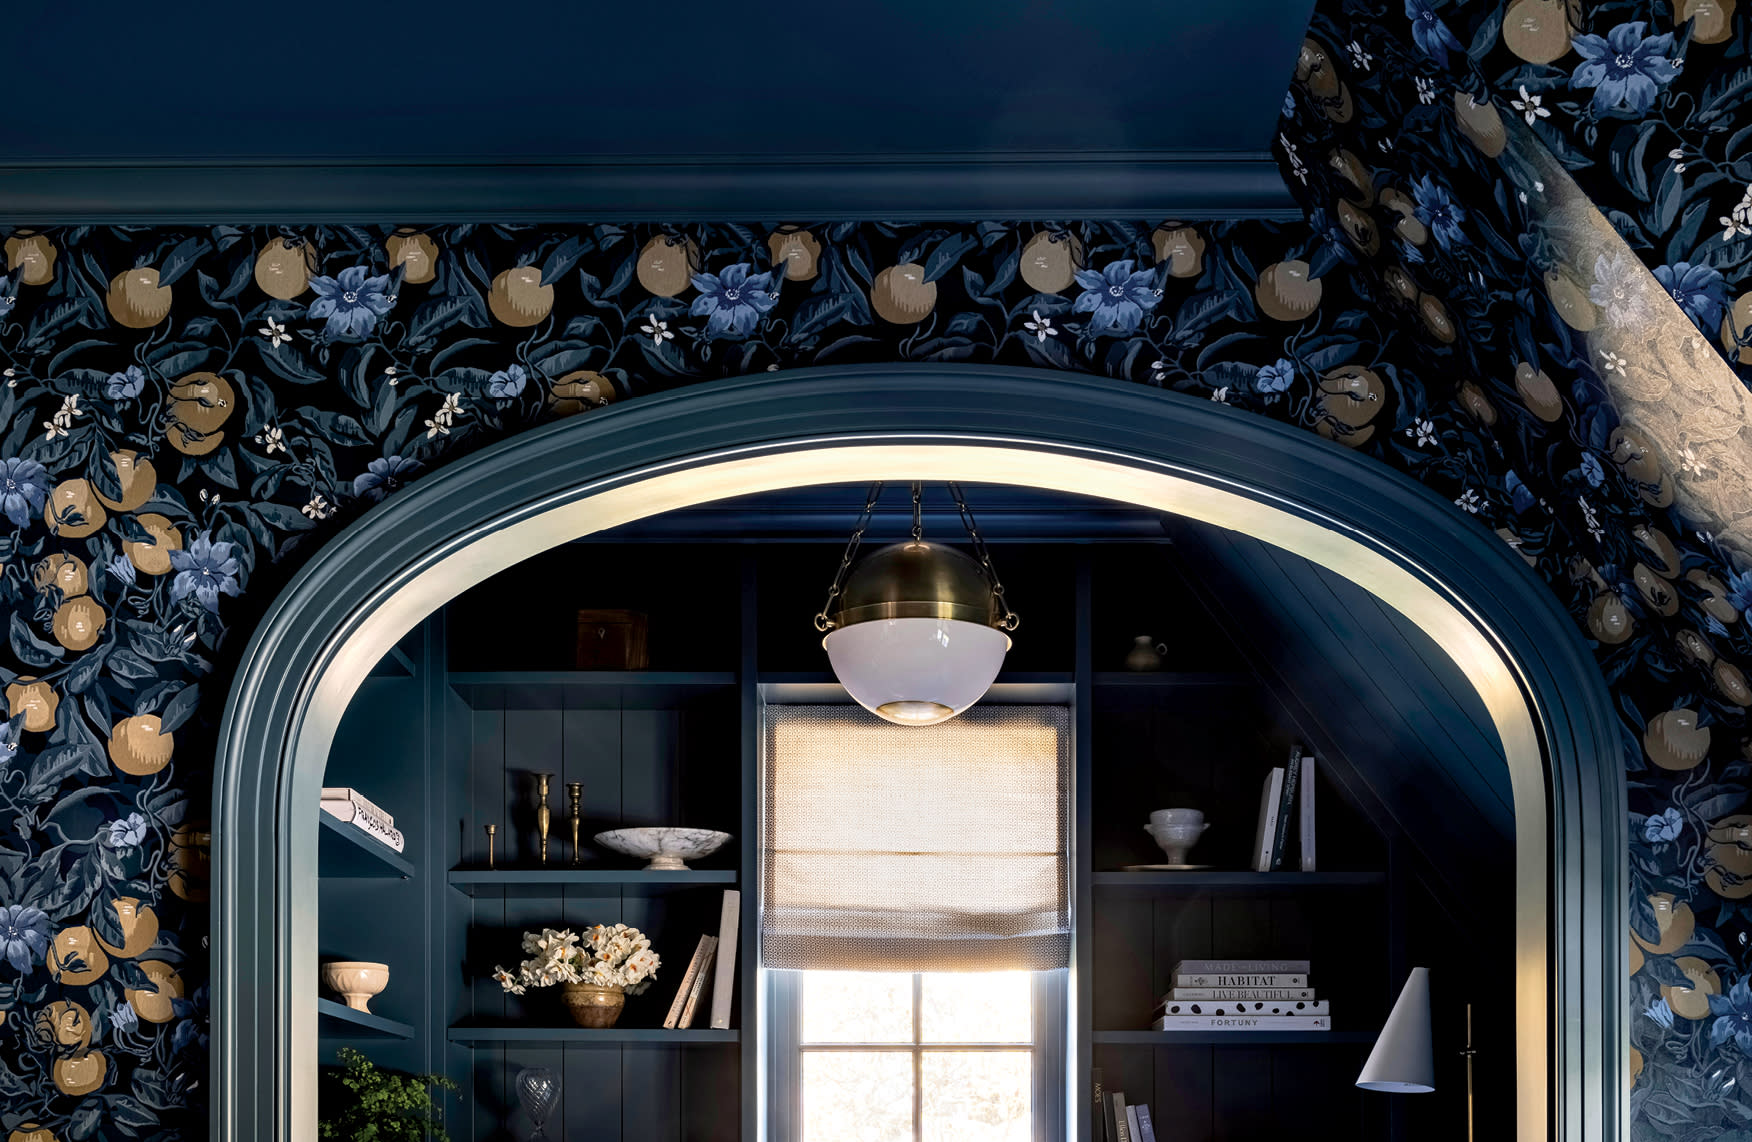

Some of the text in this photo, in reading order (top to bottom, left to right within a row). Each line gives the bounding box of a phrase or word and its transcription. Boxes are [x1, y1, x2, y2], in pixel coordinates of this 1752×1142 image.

[1218, 976, 1276, 986] HABITAT
[1212, 990, 1235, 1000] LIVE
[1236, 990, 1294, 1000] BEAUTIFUL
[1210, 1019, 1259, 1027] FORTUNY
